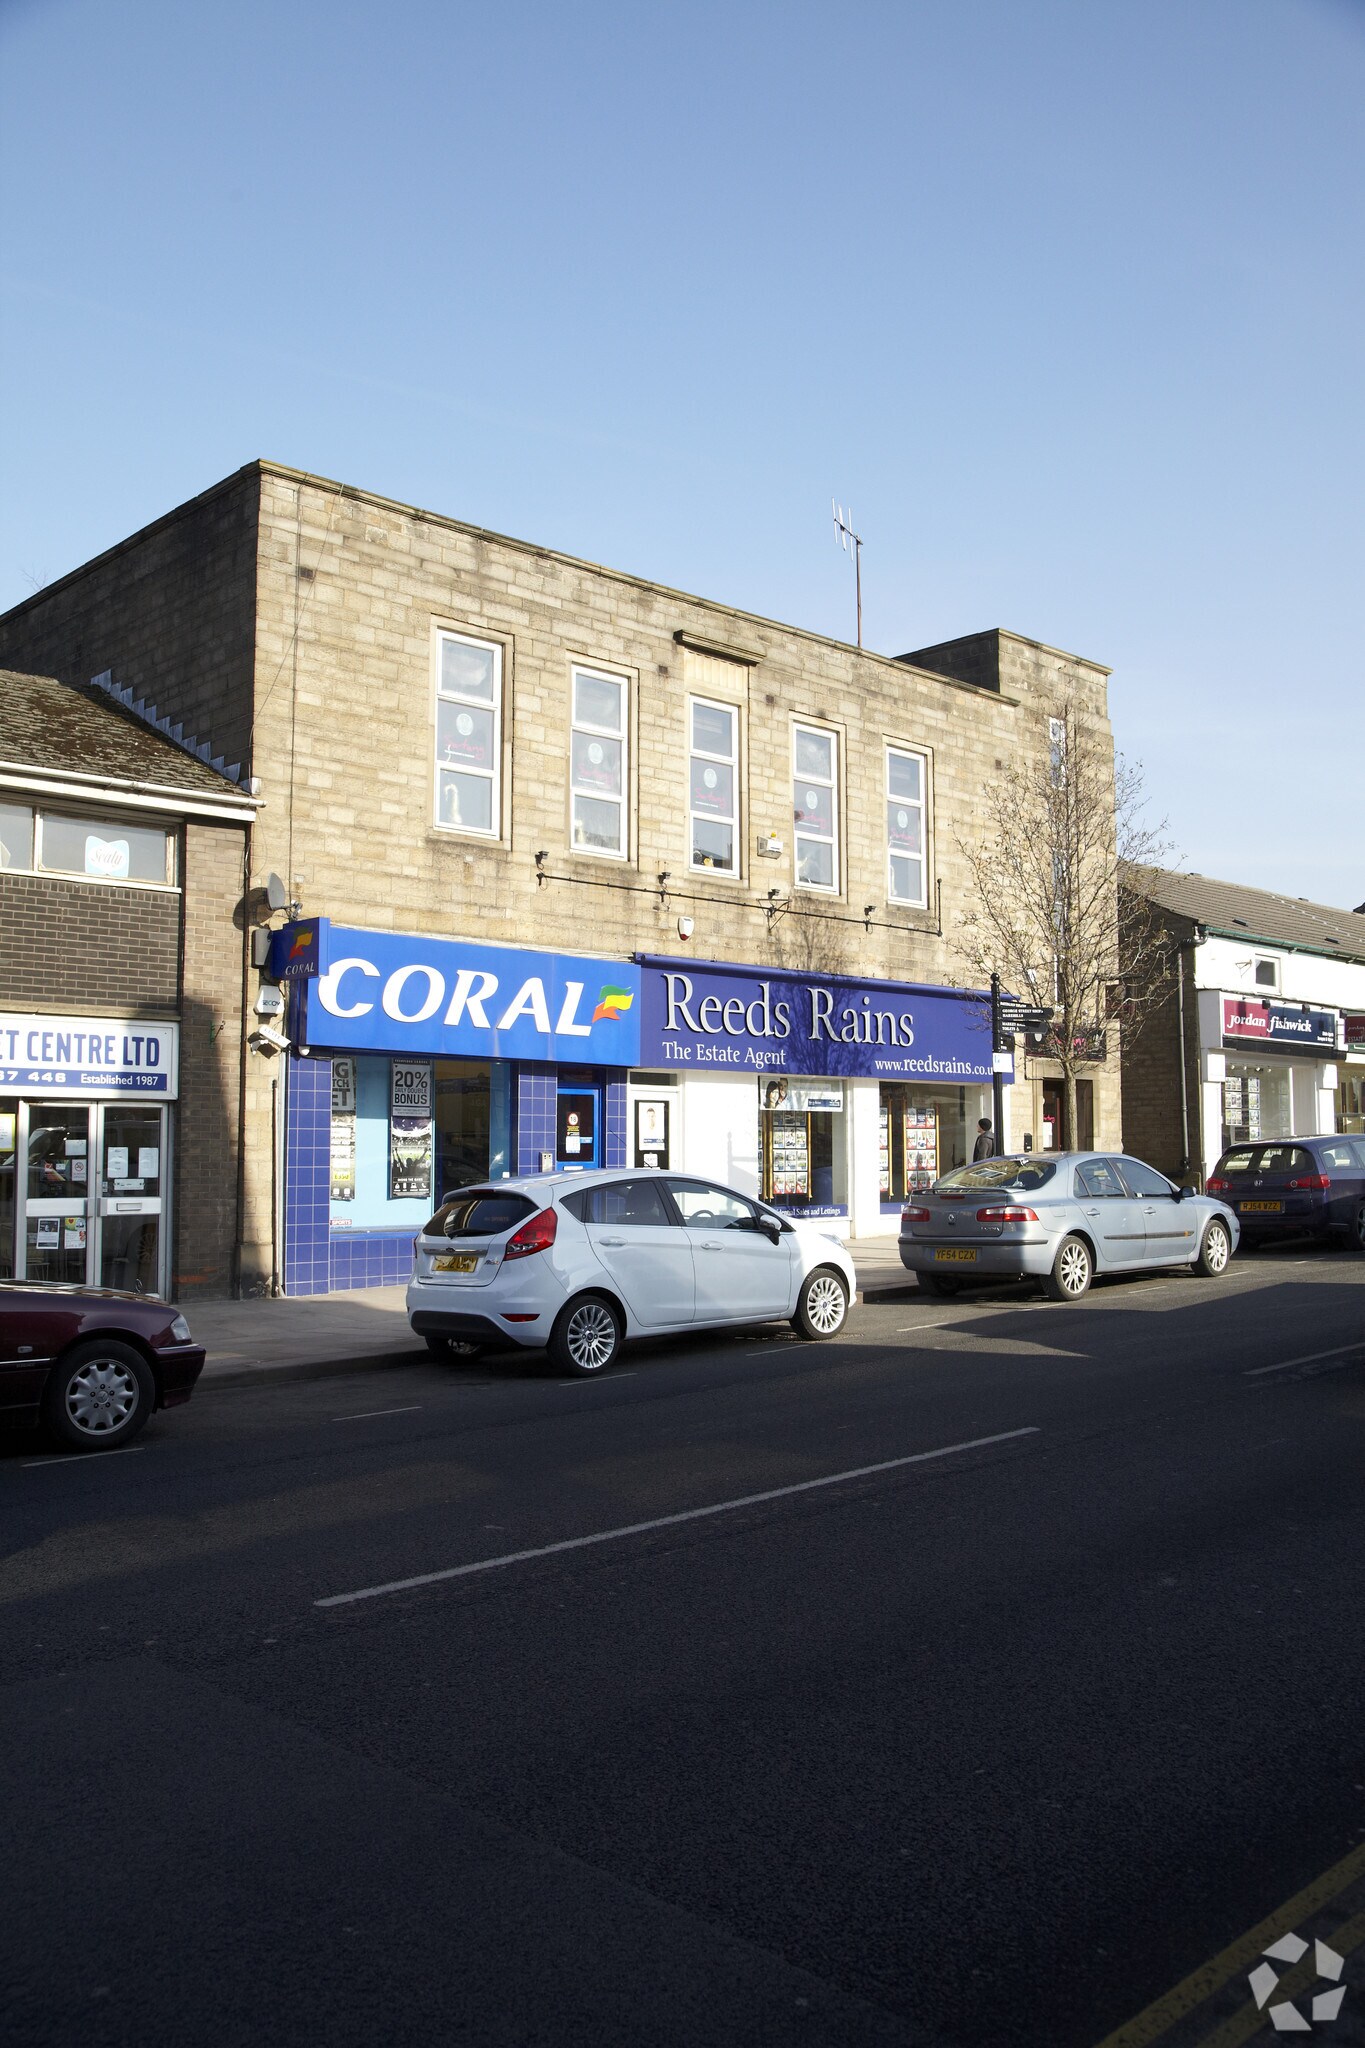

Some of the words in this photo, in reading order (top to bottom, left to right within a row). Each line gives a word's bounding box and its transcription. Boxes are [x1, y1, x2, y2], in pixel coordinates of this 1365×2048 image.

[285, 962, 315, 976] CORAL
[318, 957, 592, 1037] CORAL
[661, 972, 791, 1039] Reeds
[807, 987, 915, 1048] Rains
[1226, 1013, 1266, 1029] jordan
[1266, 1015, 1312, 1033] fishwick
[0, 1029, 20, 1061] T
[26, 1031, 116, 1065] CENTRE
[122, 1036, 160, 1067] LTD
[662, 1041, 692, 1060] The
[696, 1043, 741, 1064] Estate
[744, 1047, 786, 1069] Agent
[875, 1054, 993, 1076] www.reedsrains.co.u
[80, 1073, 133, 1086] Established
[135, 1076, 158, 1086] 1987
[332, 1078, 350, 1088] TCH
[394, 1070, 429, 1089] 20%
[332, 1088, 351, 1107] ET
[394, 1093, 429, 1105] BONUS
[796, 1208, 810, 1216] Sales
[811, 1207, 820, 1215] and
[820, 1206, 841, 1216] Lettings
[936, 1250, 957, 1260] YF54
[958, 1251, 975, 1260] CZX
